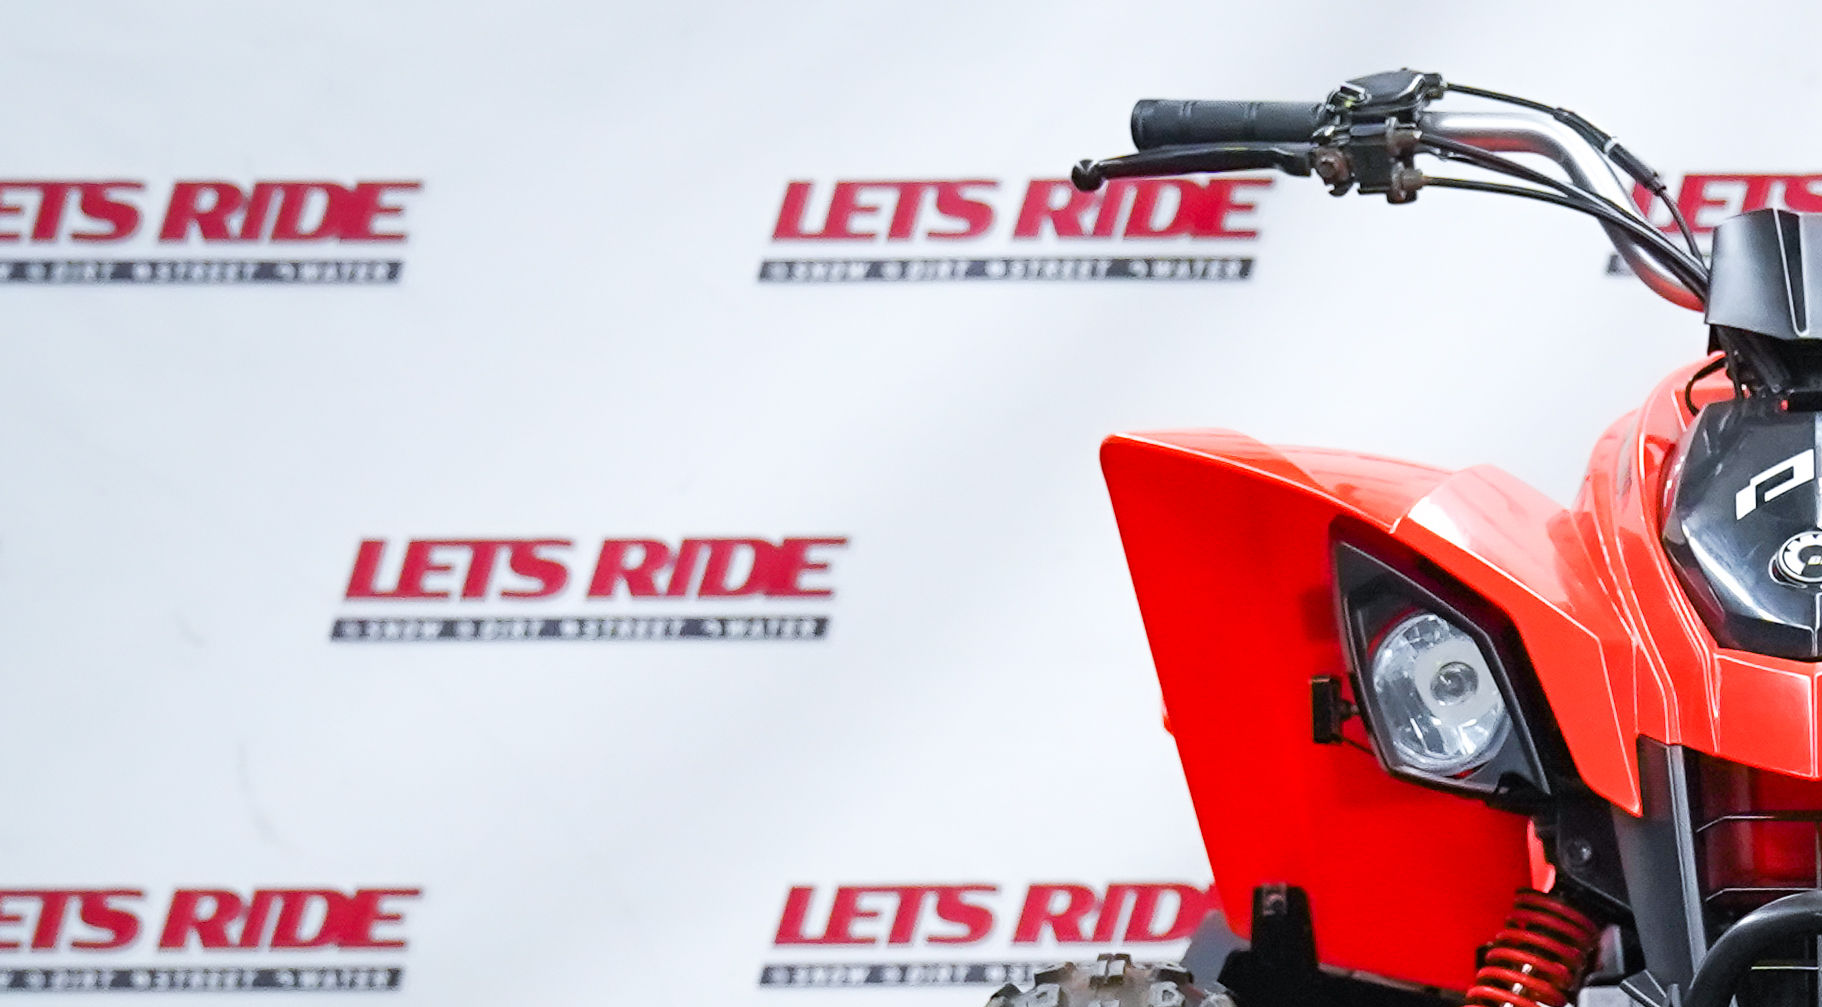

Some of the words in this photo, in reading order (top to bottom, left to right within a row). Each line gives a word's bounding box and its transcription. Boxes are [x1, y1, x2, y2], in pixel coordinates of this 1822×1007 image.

[159, 182, 420, 240] RIDE
[772, 180, 998, 240] LETS
[1013, 178, 1273, 238] RIDE
[345, 538, 574, 599] LETS
[587, 537, 848, 598] RIDE
[158, 888, 420, 949] RIDE
[774, 885, 998, 945] LETS
[1012, 883, 1225, 943] RID
